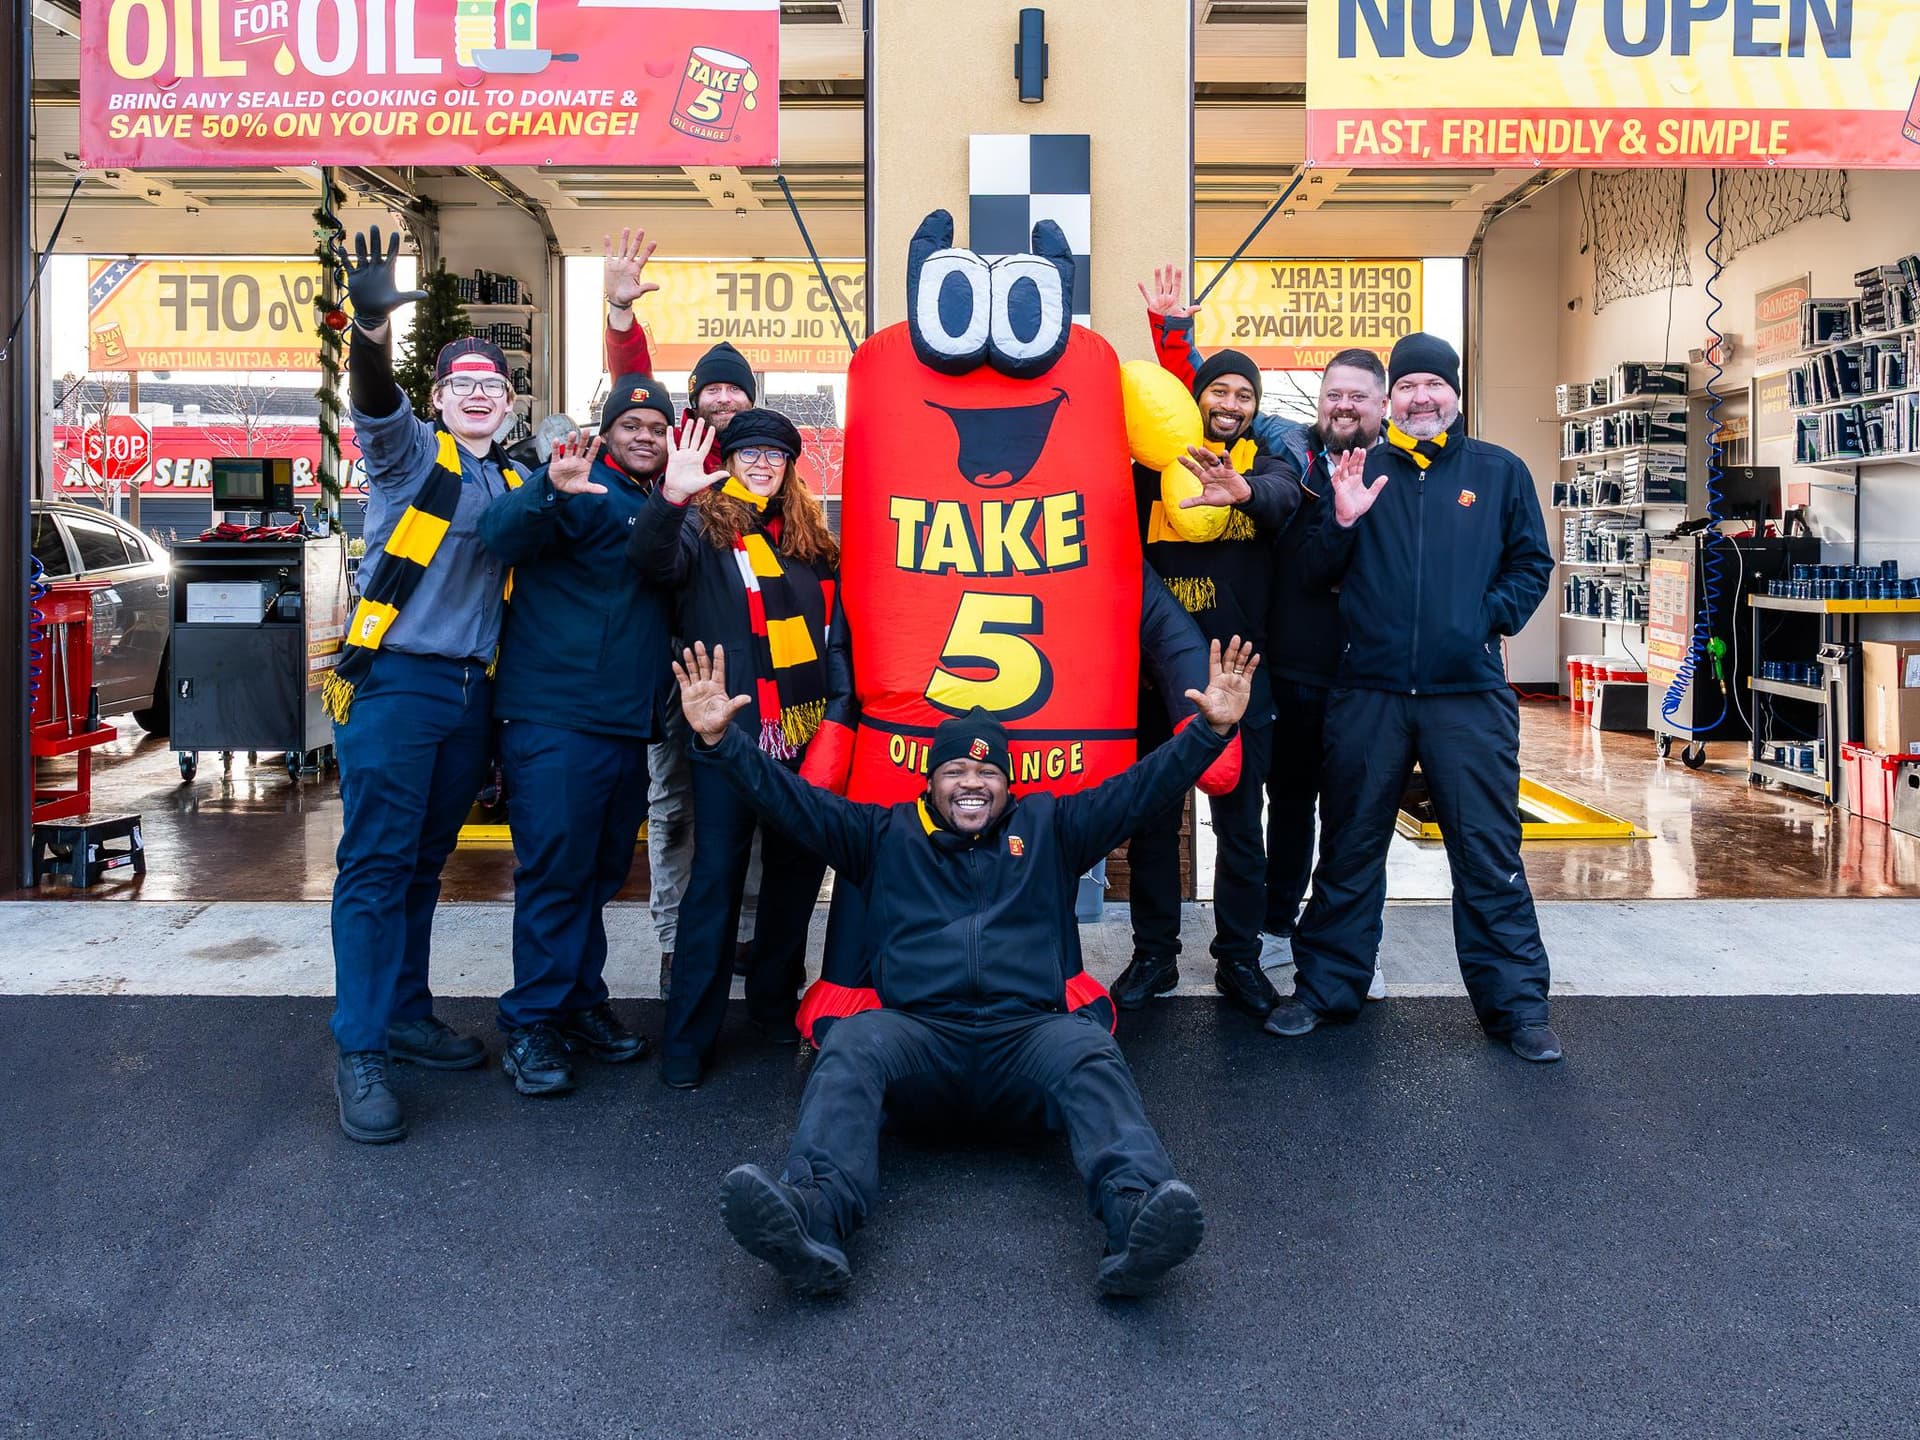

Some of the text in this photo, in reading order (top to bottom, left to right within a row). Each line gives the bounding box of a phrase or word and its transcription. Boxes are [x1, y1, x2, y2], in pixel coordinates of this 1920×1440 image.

[108, 0, 443, 79] OIL FOR OIL
[1338, 0, 1851, 59] NOW OPEN
[687, 57, 742, 93] TAKE
[108, 89, 638, 110] BRING ANY SEALED COOKING OIL TO DONATE &
[686, 87, 724, 123] 5
[108, 111, 640, 139] SAVE 50% ON YOUR OIL CHANGE!
[673, 118, 726, 140] OIL CHANGE
[1336, 118, 1789, 158] FAST, FRIENDLY & SIMPLE
[1763, 292, 1800, 318] DANGER
[89, 435, 145, 460] STOP
[293, 457, 314, 487] &
[889, 490, 1088, 577] TAKE
[924, 591, 1054, 722] 5
[889, 734, 929, 774] OIL
